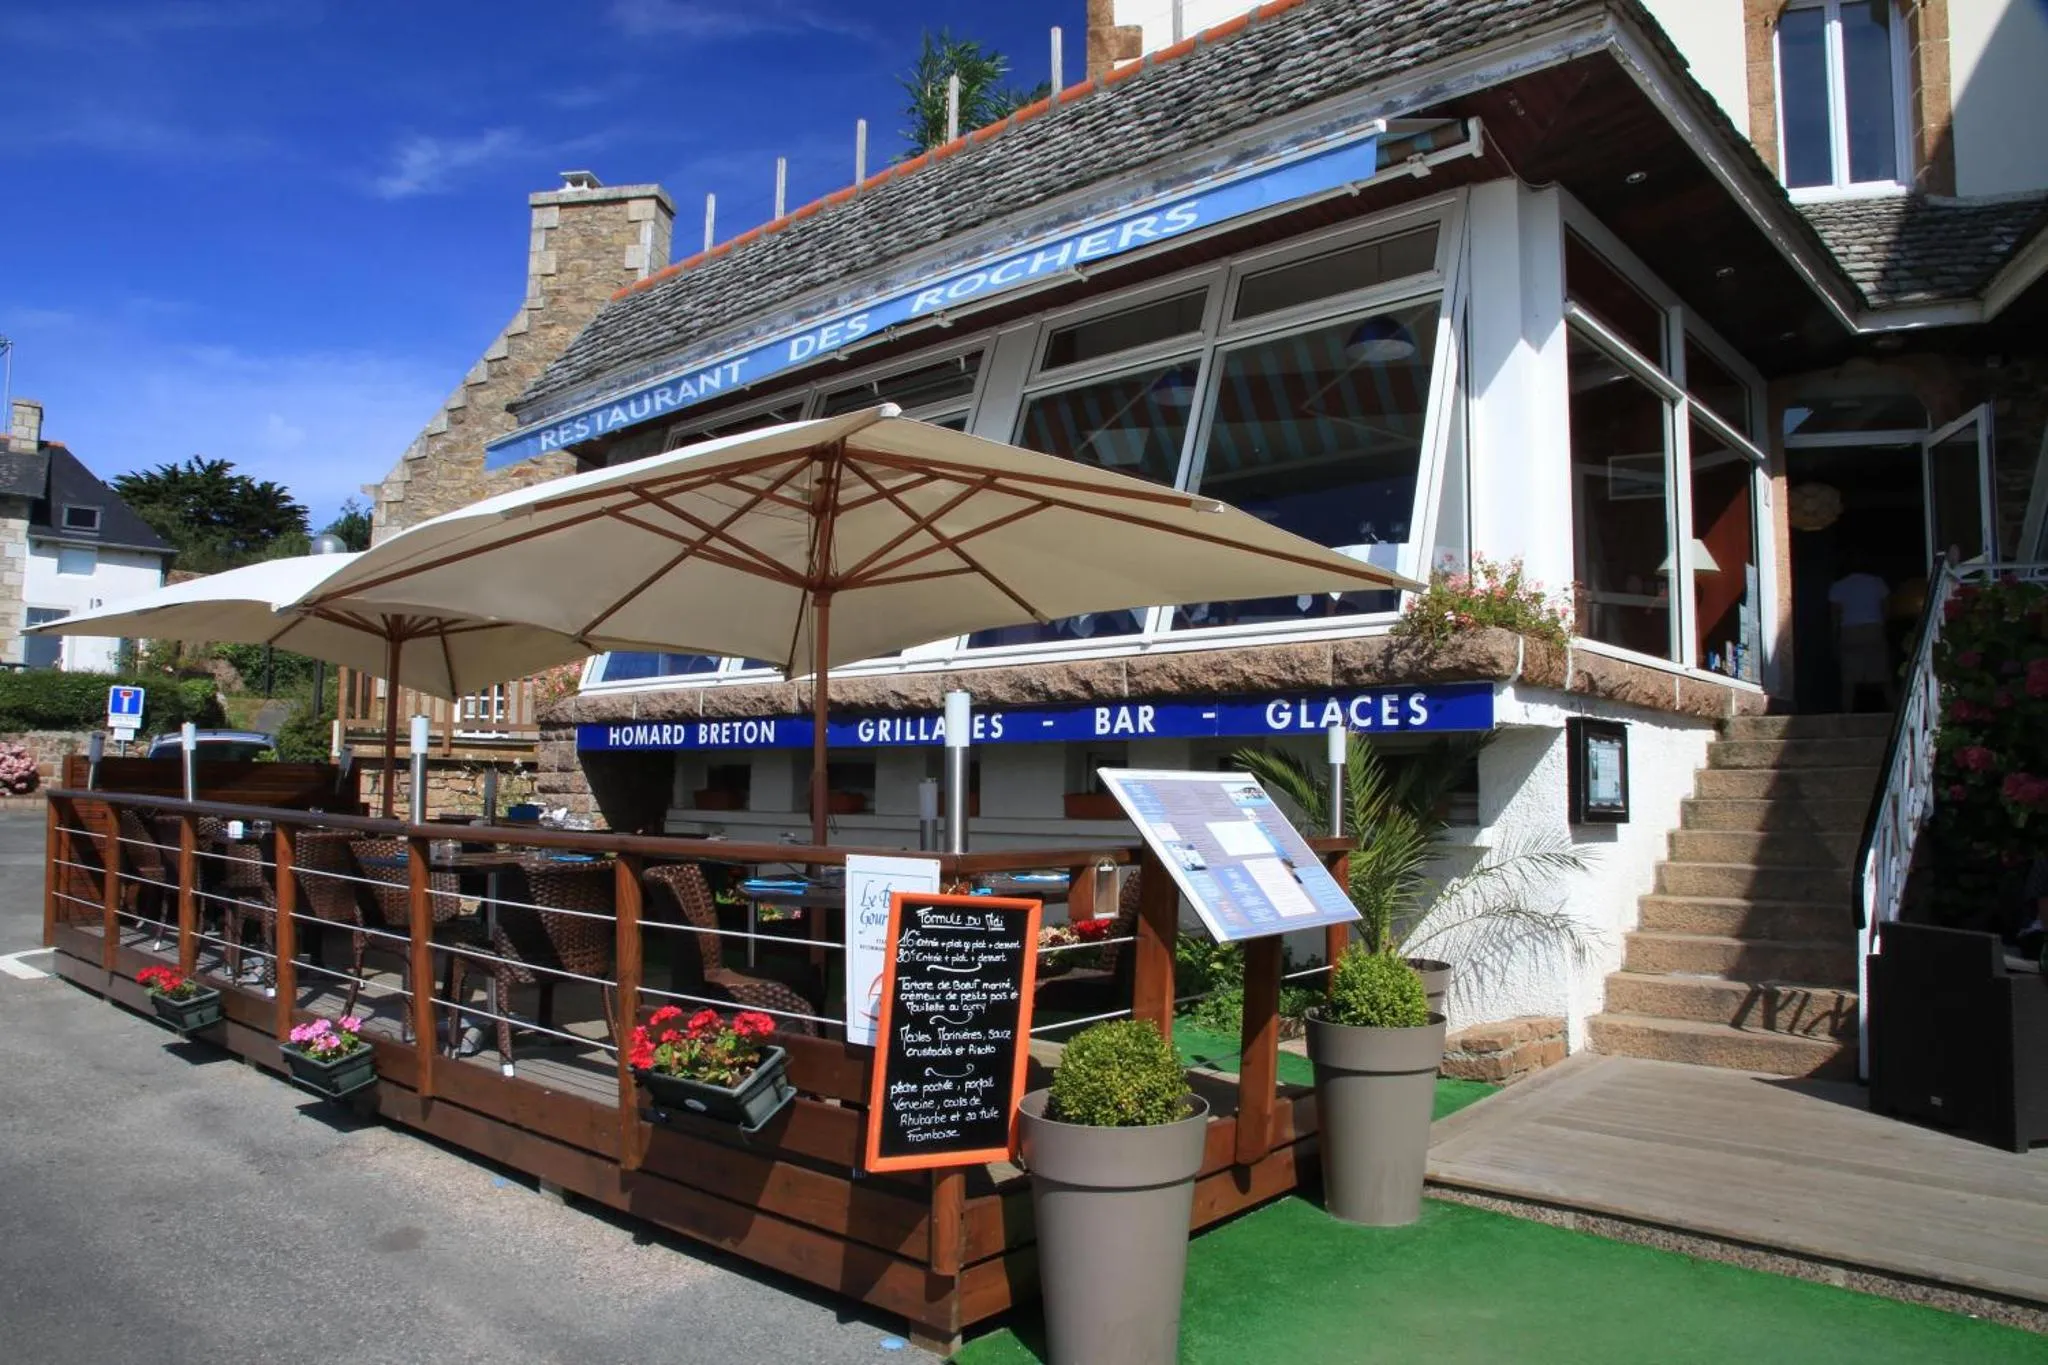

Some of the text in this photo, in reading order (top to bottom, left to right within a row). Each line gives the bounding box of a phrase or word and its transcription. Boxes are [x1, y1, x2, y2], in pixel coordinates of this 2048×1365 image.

[540, 200, 1201, 451] RESTAURANT DES ROCHERS
[608, 722, 685, 747] HOMARD
[698, 720, 776, 744] BRETON
[858, 714, 1004, 743] GRILLAES
[1095, 704, 1156, 735] BAR
[1266, 693, 1429, 730] GLACES
[945, 992, 957, 1000] de
[949, 1110, 960, 1121] et
